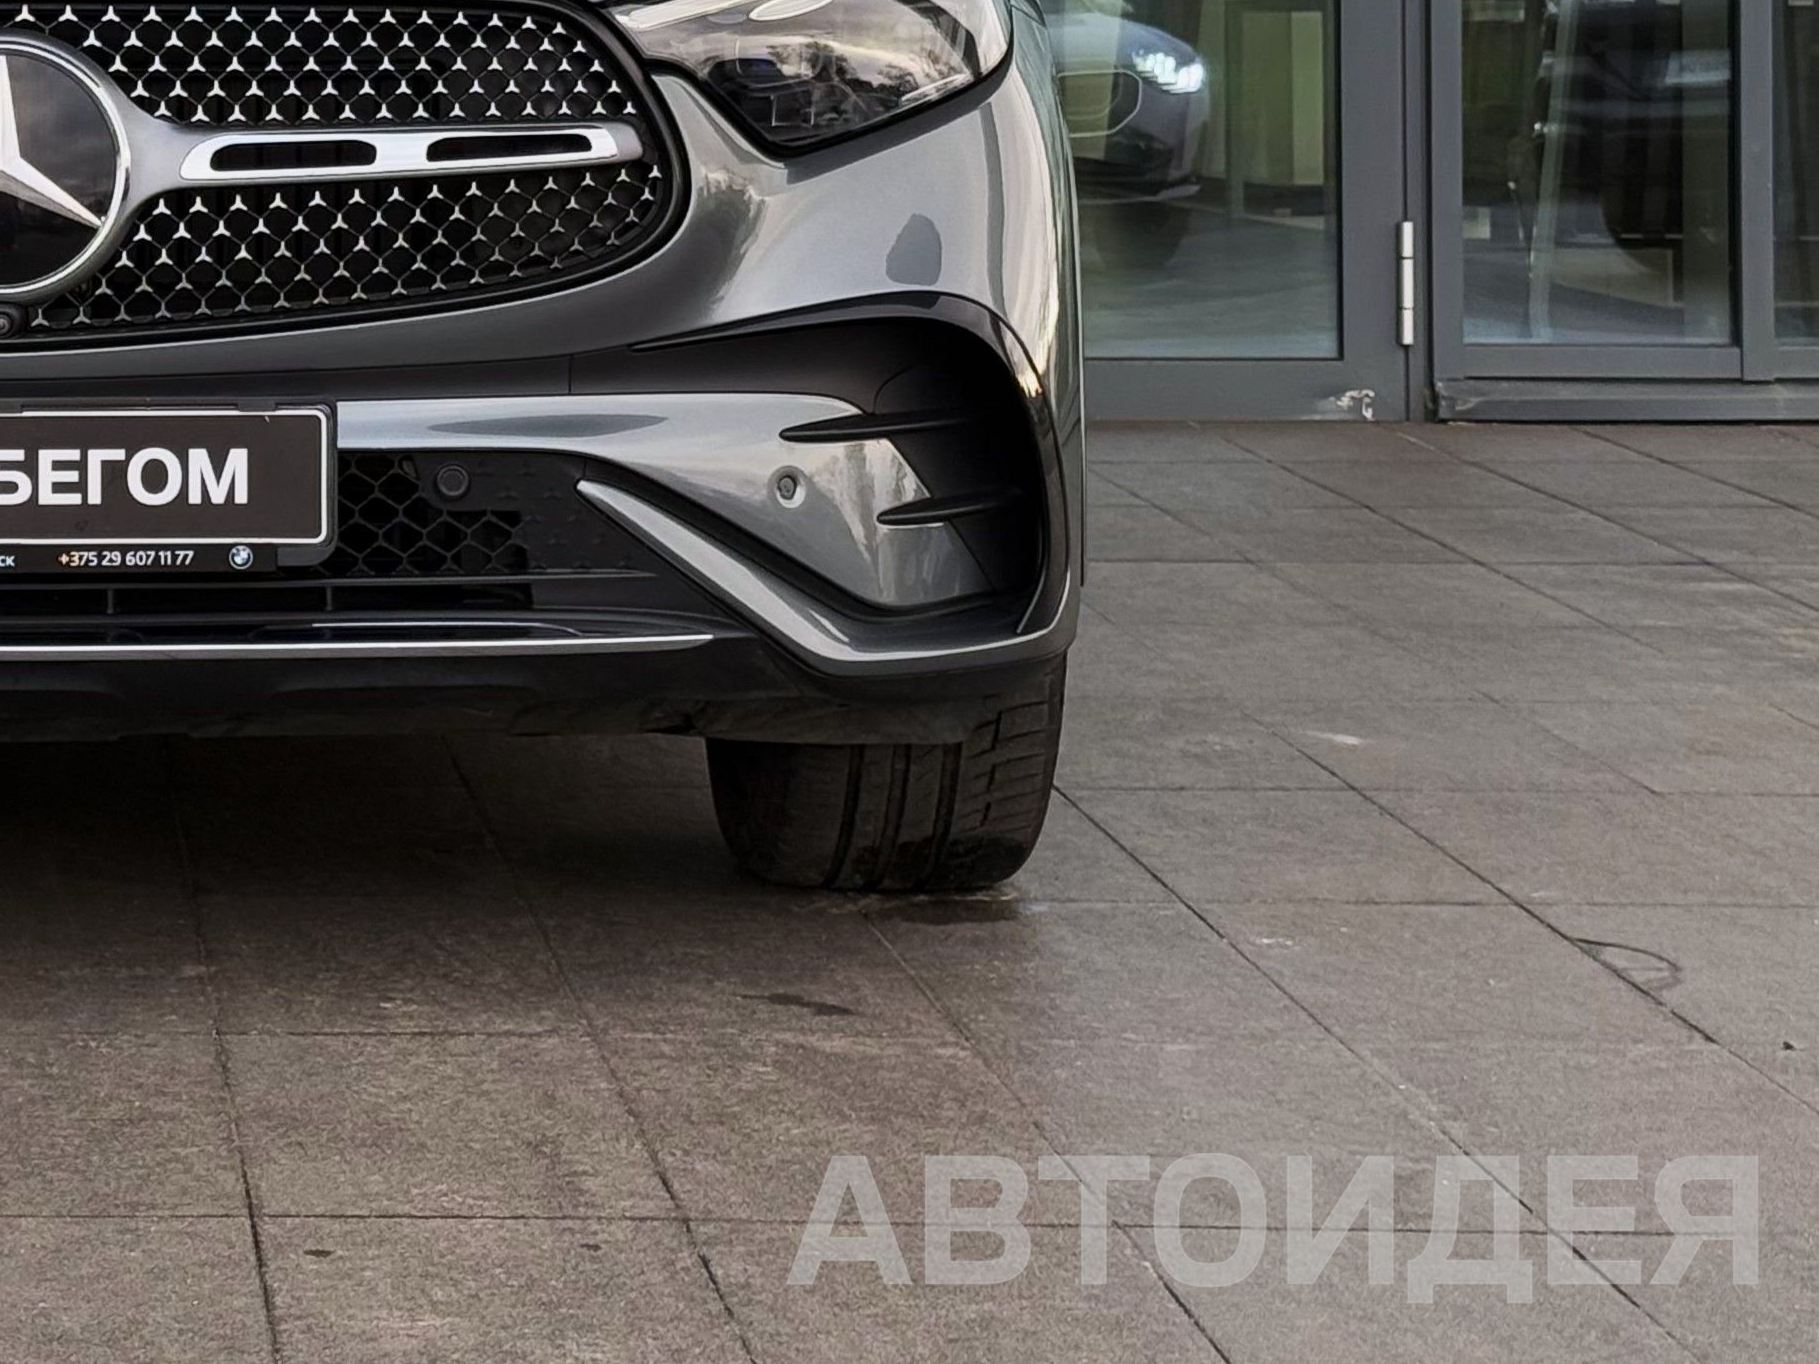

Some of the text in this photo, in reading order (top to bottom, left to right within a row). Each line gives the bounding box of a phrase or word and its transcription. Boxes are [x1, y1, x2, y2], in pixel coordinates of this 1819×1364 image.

[59, 551, 98, 566] +375
[102, 551, 122, 566] 29
[126, 551, 155, 566] 607
[158, 551, 172, 566] 11
[176, 551, 194, 566] 77
